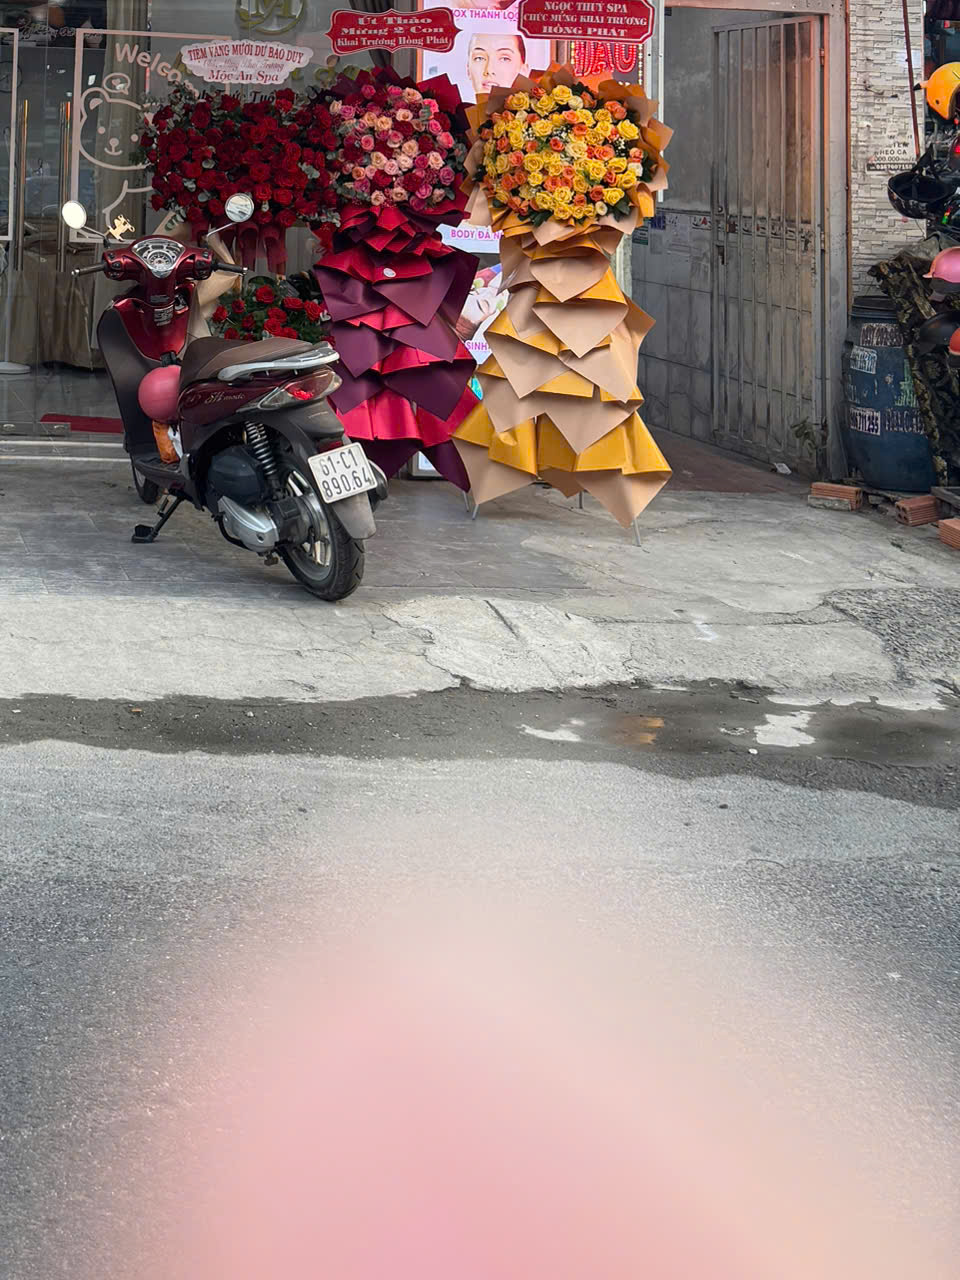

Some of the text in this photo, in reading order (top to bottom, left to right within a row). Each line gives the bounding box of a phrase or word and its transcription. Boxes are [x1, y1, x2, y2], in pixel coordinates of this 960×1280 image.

[544, 1, 627, 13] NGỌC SPA
[470, 9, 500, 19] THANH
[542, 23, 627, 37] HỒNG PHÁT
[337, 38, 358, 46] Khai
[361, 37, 396, 46] Trương
[426, 34, 449, 44] Phát
[287, 50, 304, 64] DUY
[208, 70, 279, 84] Mộc An Spa
[451, 229, 475, 239] BODY
[465, 341, 488, 351] SINH
[320, 449, 358, 476] 61-C1
[322, 467, 371, 498] 890.64
